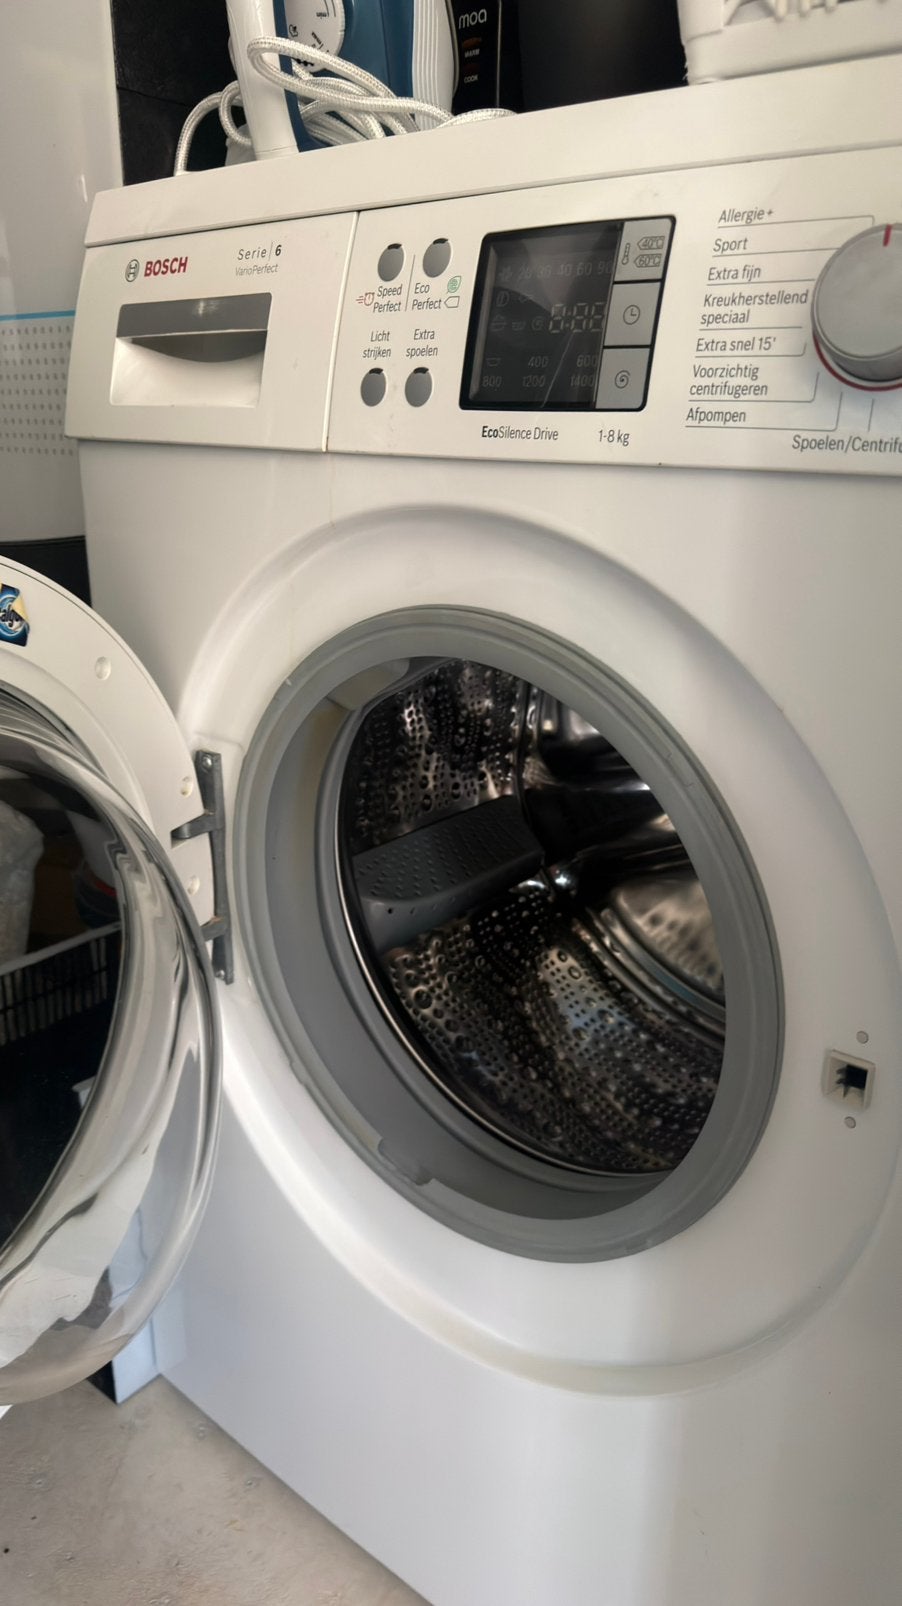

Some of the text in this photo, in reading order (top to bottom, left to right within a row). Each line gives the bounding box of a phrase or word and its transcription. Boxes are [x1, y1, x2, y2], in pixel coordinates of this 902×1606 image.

[458, 9, 488, 29] moa
[463, 75, 479, 84] COOK
[237, 244, 282, 261] Serie 6
[713, 237, 748, 254] Sport
[144, 256, 188, 277] BOSCH
[235, 263, 279, 277] VarioPerfect
[576, 262, 592, 276] 60
[708, 264, 762, 282] Extra fijn
[377, 284, 403, 298] Speed
[414, 282, 430, 294] Eco
[411, 299, 441, 311] Perfect
[703, 289, 810, 307] Kreukherstellend
[372, 301, 401, 313] Perfect
[700, 310, 751, 326] speciaal
[370, 330, 390, 342] Licht
[413, 328, 435, 340] Extra
[405, 345, 438, 359] spoelen
[696, 336, 777, 353] Extra snel 15'
[362, 346, 391, 360] strijken
[527, 354, 597, 368] 400 600
[693, 364, 760, 381] Voorzichtig
[481, 374, 595, 388] 800 1200 1400
[689, 382, 769, 399] centrifugeren
[686, 407, 747, 424] Afpompen
[481, 425, 559, 441] EcoSilence Drive
[599, 429, 630, 446] 1-8 kg
